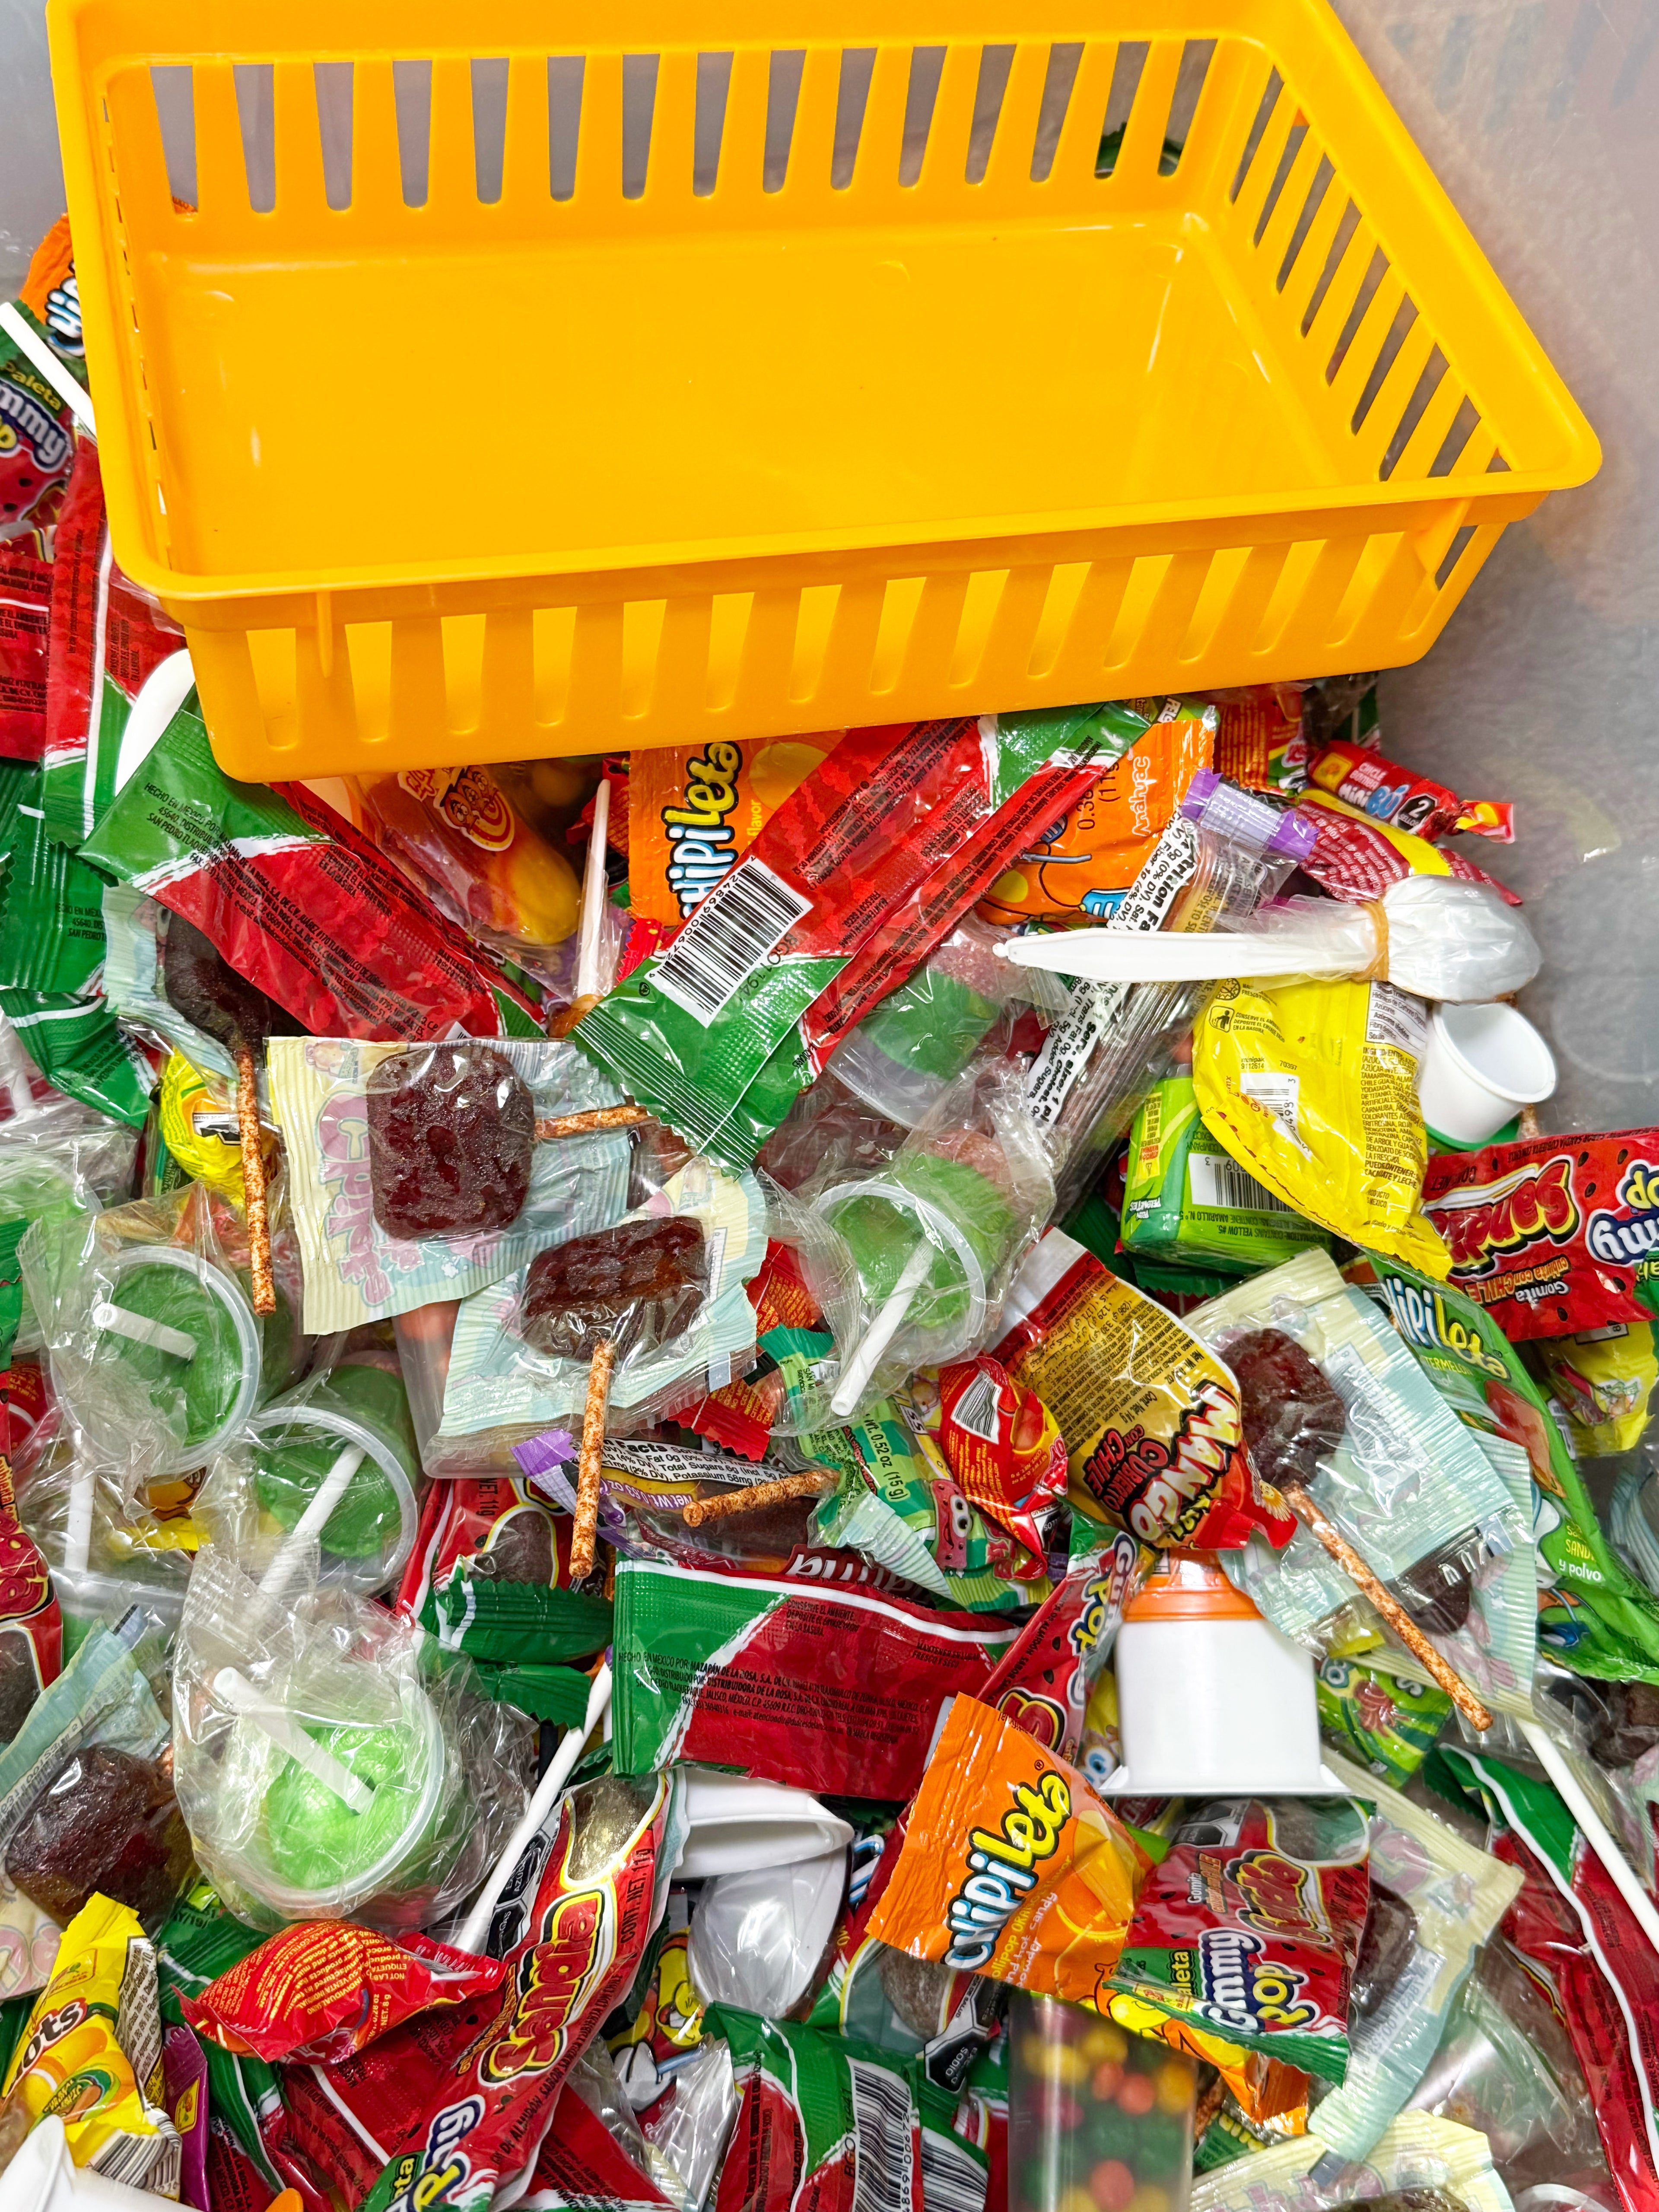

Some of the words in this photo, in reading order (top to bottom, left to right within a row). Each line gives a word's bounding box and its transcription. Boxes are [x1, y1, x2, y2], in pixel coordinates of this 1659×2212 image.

[144, 782, 168, 802] HECHO
[1409, 796, 1430, 818] 2
[147, 813, 162, 826] SAN
[161, 821, 183, 839] PEDRO
[747, 799, 763, 840] flavor
[1325, 826, 1339, 839] rojo
[1165, 845, 1184, 864] 0g
[1152, 860, 1170, 880] (0%
[703, 871, 738, 916] 24869
[859, 890, 880, 911] FRESCO
[1128, 904, 1144, 923] Sat.
[67, 929, 81, 938] SAN
[663, 919, 700, 962] 00672
[1074, 998, 1095, 1024] Trans
[1056, 1018, 1074, 1036] 5g
[1064, 1022, 1084, 1044] Fat
[1069, 1021, 1097, 1055] Serv.
[1047, 1035, 1068, 1065] Added
[1241, 1056, 1264, 1065] minipak
[1241, 1060, 1264, 1071] 9112614
[1026, 1066, 1055, 1099] Sugars,
[1361, 1104, 1394, 1114] CARNAUBA,
[1361, 1111, 1398, 1120] COLORANTES
[1366, 1144, 1394, 1153] BENZOATO
[1205, 1157, 1210, 1165] 3
[1197, 1212, 1228, 1222] AMARILLO
[1228, 1226, 1252, 1236] YELLOW
[1465, 1274, 1515, 1303] CHILE
[1513, 1270, 1533, 1286] con
[1515, 1281, 1568, 1301] Gomita
[1130, 1402, 1145, 1415] Net.
[1140, 1391, 1157, 1407] Cont.
[871, 1433, 889, 1454] 0.52
[1123, 1424, 1145, 1450] CON
[618, 1453, 636, 1464] (4%
[659, 1461, 686, 1475] Total
[690, 1462, 723, 1474] Sugars
[726, 1465, 738, 1475] 6g
[645, 1455, 663, 1465] Fat
[665, 1454, 679, 1462] 0g
[880, 1456, 892, 1468] oz
[1084, 1429, 1126, 1494] CHILE
[1129, 1382, 1241, 1541] MANGO
[629, 1466, 650, 1477] (2%
[651, 1470, 674, 1481] DV),
[674, 1465, 727, 1483] Potassium
[727, 1474, 752, 1487] 58mg
[886, 1471, 903, 1487] (15
[1104, 1434, 1169, 1516] CUBIERTO
[889, 1487, 907, 1500] g)
[475, 1499, 498, 1518] 11g
[1559, 1560, 1566, 1572] y
[1569, 1561, 1602, 1582] polvo
[707, 1678, 754, 1693] DISTRIBUIDORA
[756, 1686, 764, 1694] DE
[766, 1687, 774, 1696] LA
[633, 1847, 659, 1869] 11g
[626, 1872, 656, 1905] NET.
[1186, 1871, 1203, 1904] Gomita
[609, 1902, 647, 1947] CONT.
[1014, 1933, 1036, 1962] hot
[1030, 1892, 1058, 1933] candy
[539, 2067, 564, 2098] SABOR
